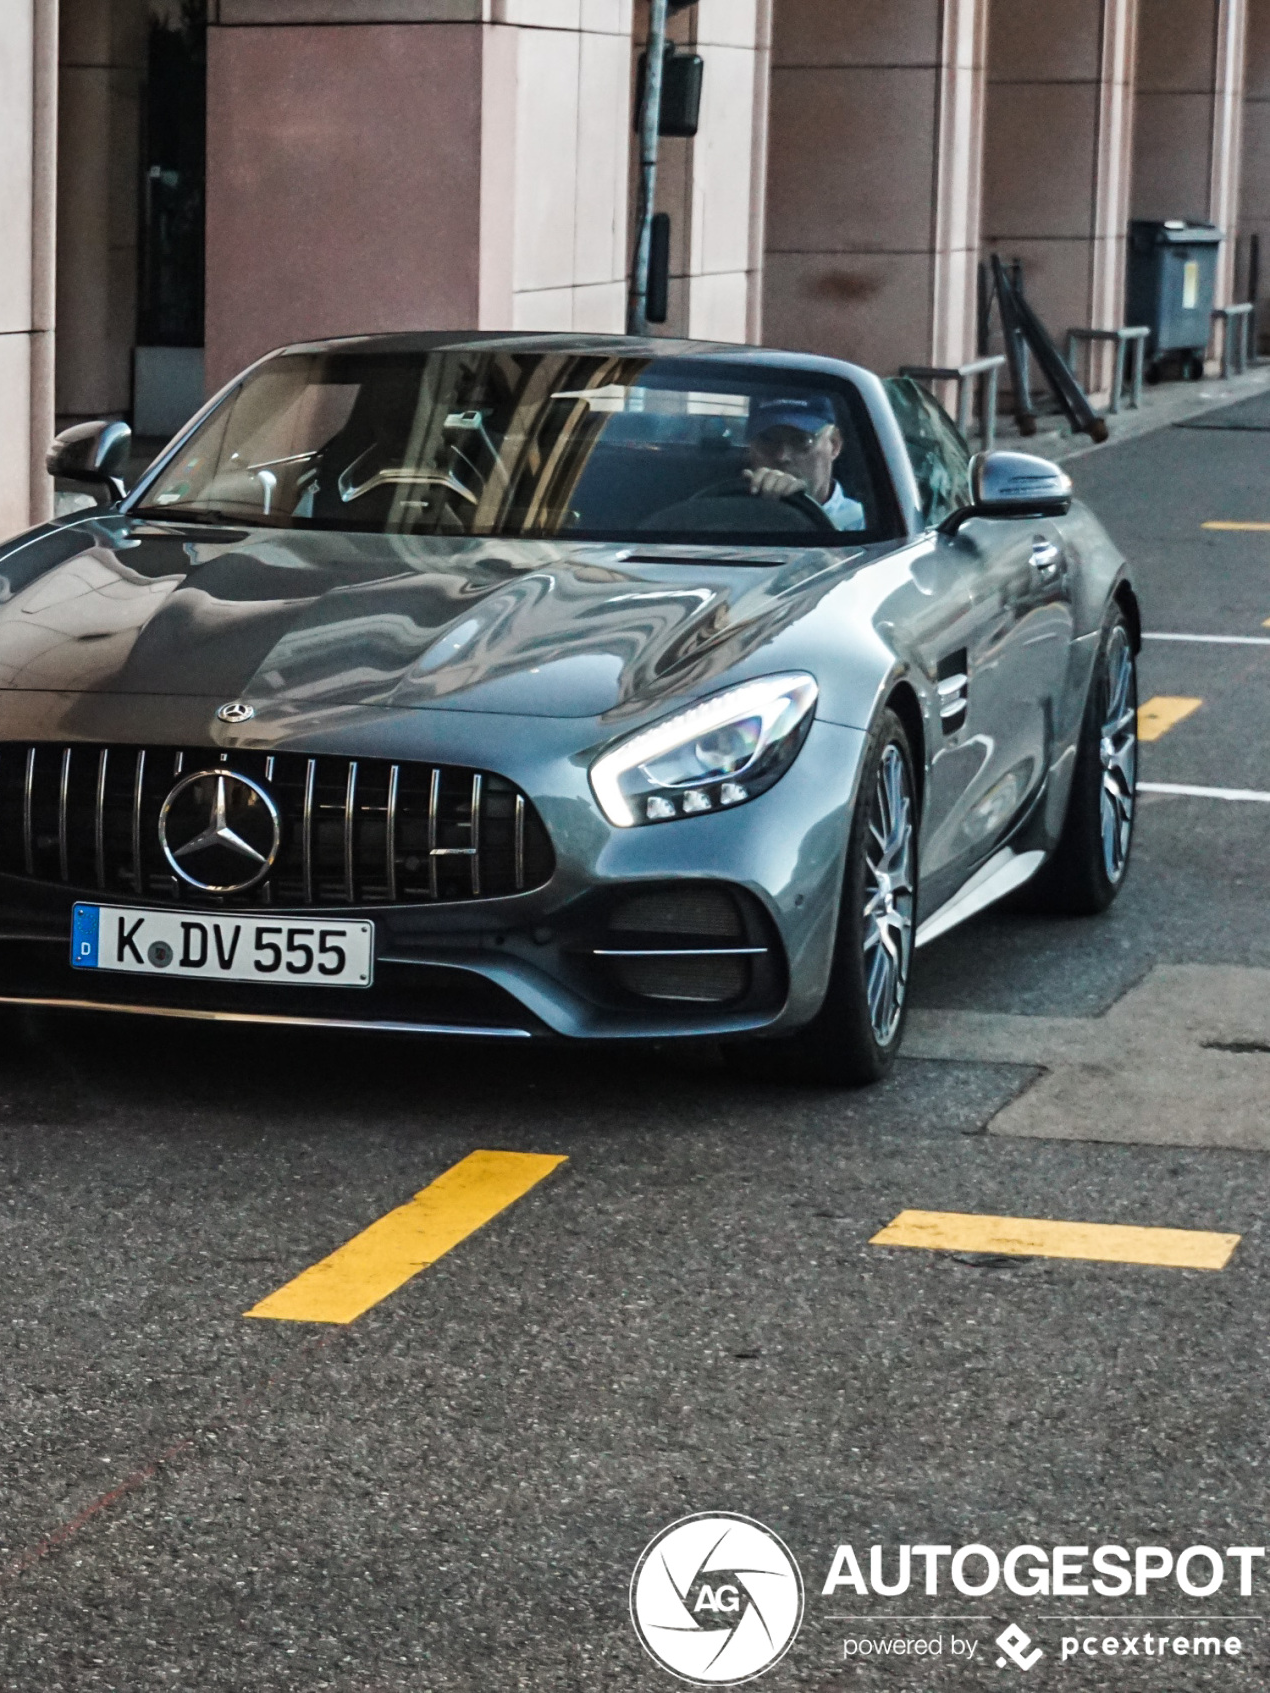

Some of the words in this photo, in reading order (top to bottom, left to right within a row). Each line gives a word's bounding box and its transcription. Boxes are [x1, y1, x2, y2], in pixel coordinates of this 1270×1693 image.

[80, 942, 91, 956] D
[116, 916, 145, 965] K
[179, 921, 242, 970] DV
[253, 926, 348, 976] 555
